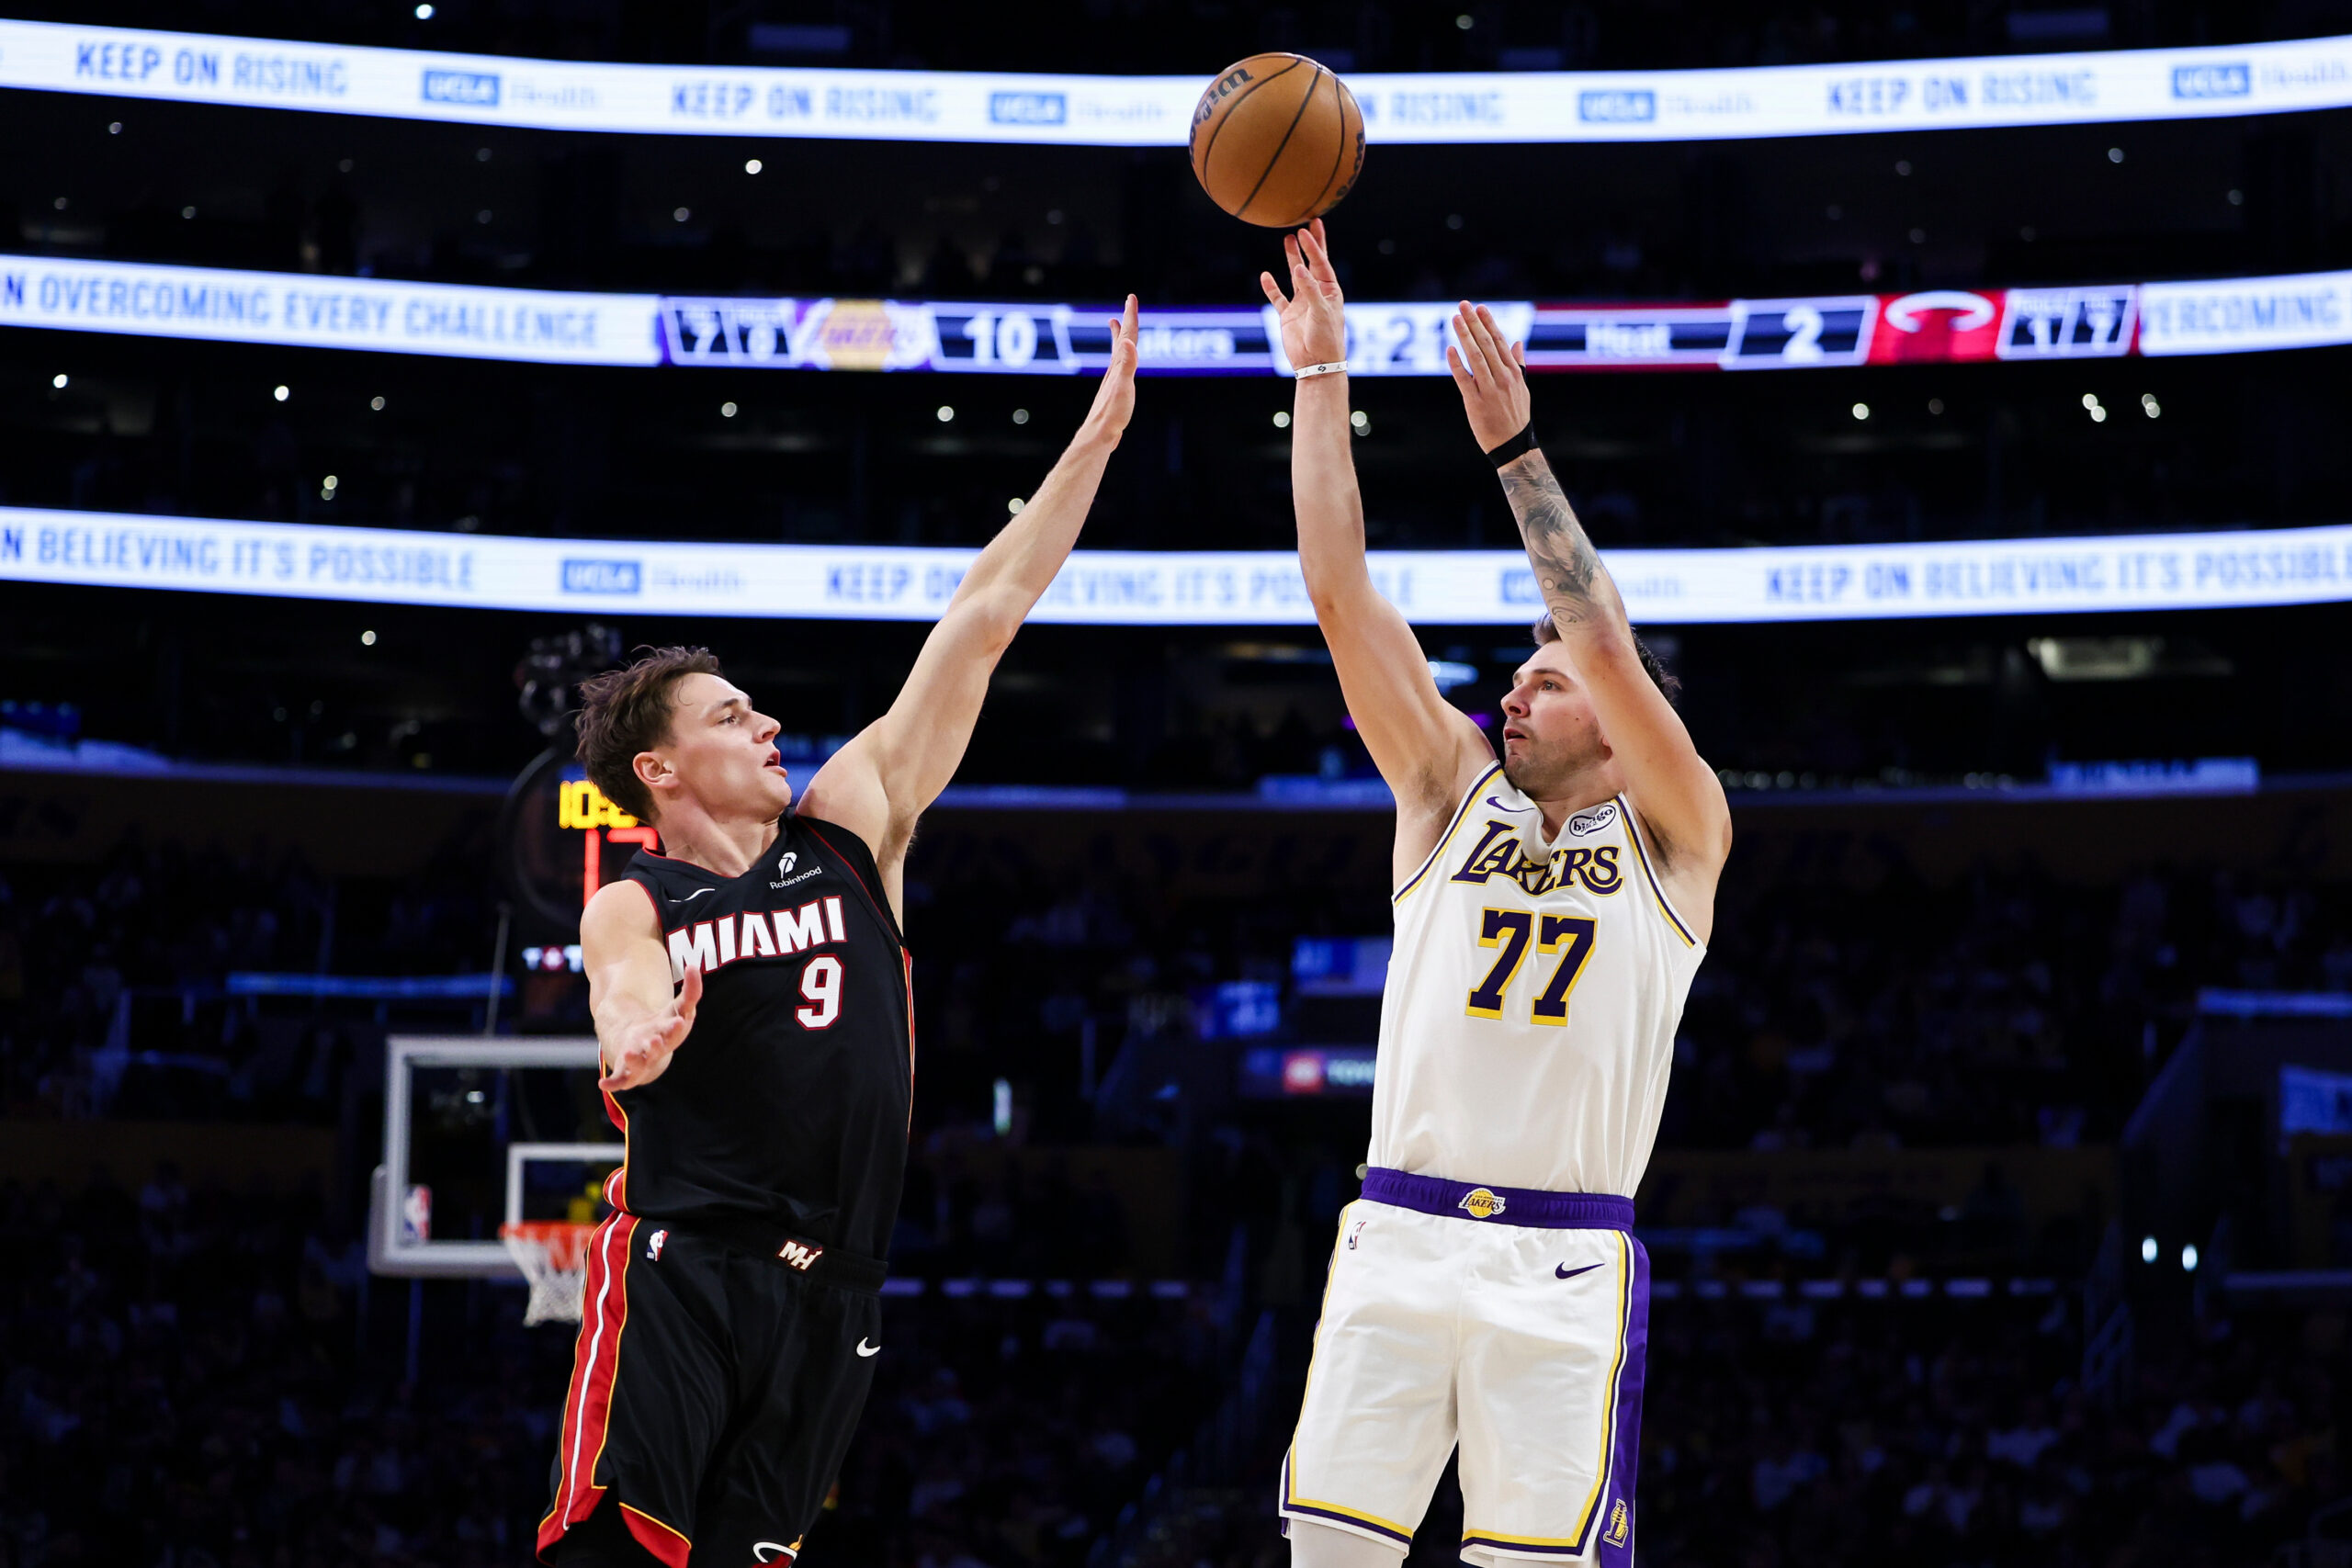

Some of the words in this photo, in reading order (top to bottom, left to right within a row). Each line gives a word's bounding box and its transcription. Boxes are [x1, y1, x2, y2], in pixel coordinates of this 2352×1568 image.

[74, 39, 163, 84] KEEP
[174, 45, 220, 88] ON
[232, 51, 349, 97] RISING
[1826, 76, 1912, 116] KEEP
[1923, 73, 1970, 113] ON
[1981, 67, 2099, 108] RISING
[670, 81, 755, 119] KEEP
[767, 81, 814, 122] ON
[825, 85, 943, 125] RISING
[1389, 90, 1505, 126] RISING
[39, 272, 271, 329] OVERCOMING
[282, 289, 393, 335] EVERY
[402, 297, 598, 350] CHALLENGE
[962, 310, 1037, 367] 10
[1782, 304, 1825, 364] 2
[37, 525, 221, 577] BELIEVING
[230, 537, 296, 581] IT'S
[307, 541, 476, 592] POSSIBLE
[825, 562, 912, 604] KEEP
[1046, 564, 1162, 608] EVING
[1249, 564, 1416, 608] POLE
[1764, 562, 1852, 603] KEEP
[1863, 560, 1914, 600] ON
[1925, 553, 2109, 601] BELIEVING
[2118, 553, 2186, 592] IT'S
[769, 865, 823, 890] Robinhood
[666, 895, 847, 985] MIAMI
[1465, 906, 1599, 1028] 77
[795, 953, 845, 1032] 9
[1462, 1193, 1504, 1213] LAKERS
